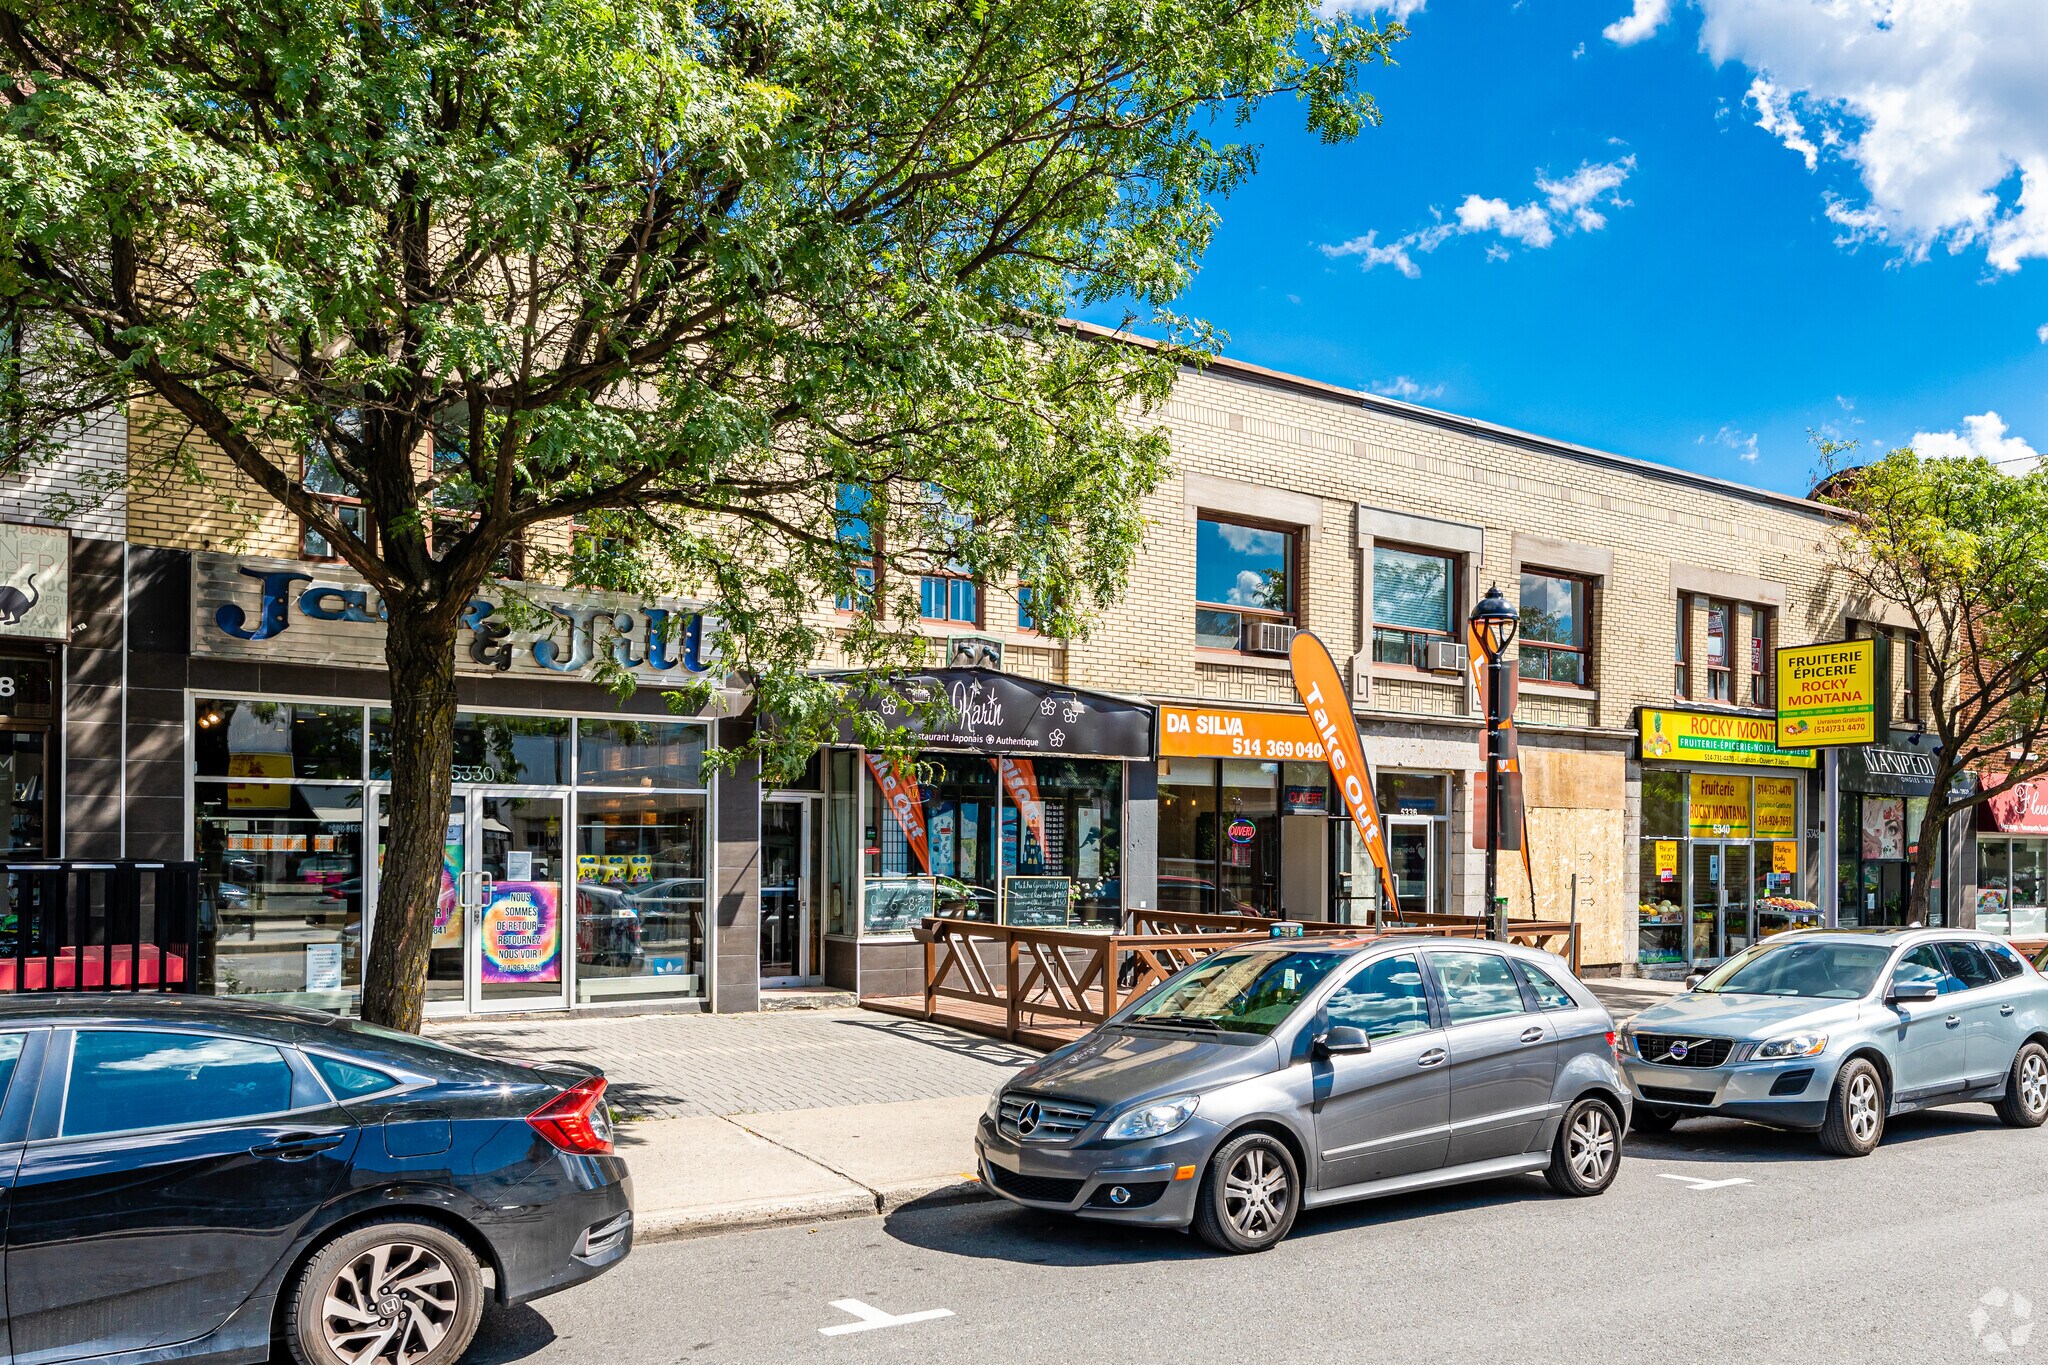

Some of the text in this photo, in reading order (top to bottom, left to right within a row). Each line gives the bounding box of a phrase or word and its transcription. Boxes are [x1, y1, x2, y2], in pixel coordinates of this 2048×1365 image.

[533, 605, 714, 673] Jill
[1788, 651, 1862, 668] FRUITERIE
[1794, 664, 1857, 679] ÉPICERIE
[1801, 678, 1848, 693] ROCKY
[1788, 690, 1863, 706] MONTANA
[1166, 713, 1244, 737] DA SILVA
[1690, 716, 1775, 740] ROCKY MONT
[1814, 723, 1866, 734] (514)731 4470
[951, 735, 984, 744] Japonais
[996, 736, 1039, 747] Authentique
[1232, 738, 1325, 759] 514 369 040
[1306, 680, 1379, 843] Take Out
[451, 764, 495, 782] 5330
[1701, 780, 1735, 797] Fruiterie
[1289, 791, 1323, 804] OUVERT
[1690, 804, 1748, 821] ROCKY MONTANA
[1229, 826, 1254, 837] OUVERT
[1712, 824, 1731, 835] 5340
[510, 892, 532, 902] NOUS
[504, 906, 538, 916] SOMMES
[496, 921, 506, 931] DE
[508, 921, 537, 931] RETOUR
[497, 935, 541, 944] RETOURNEZ
[498, 949, 519, 958] NOUS
